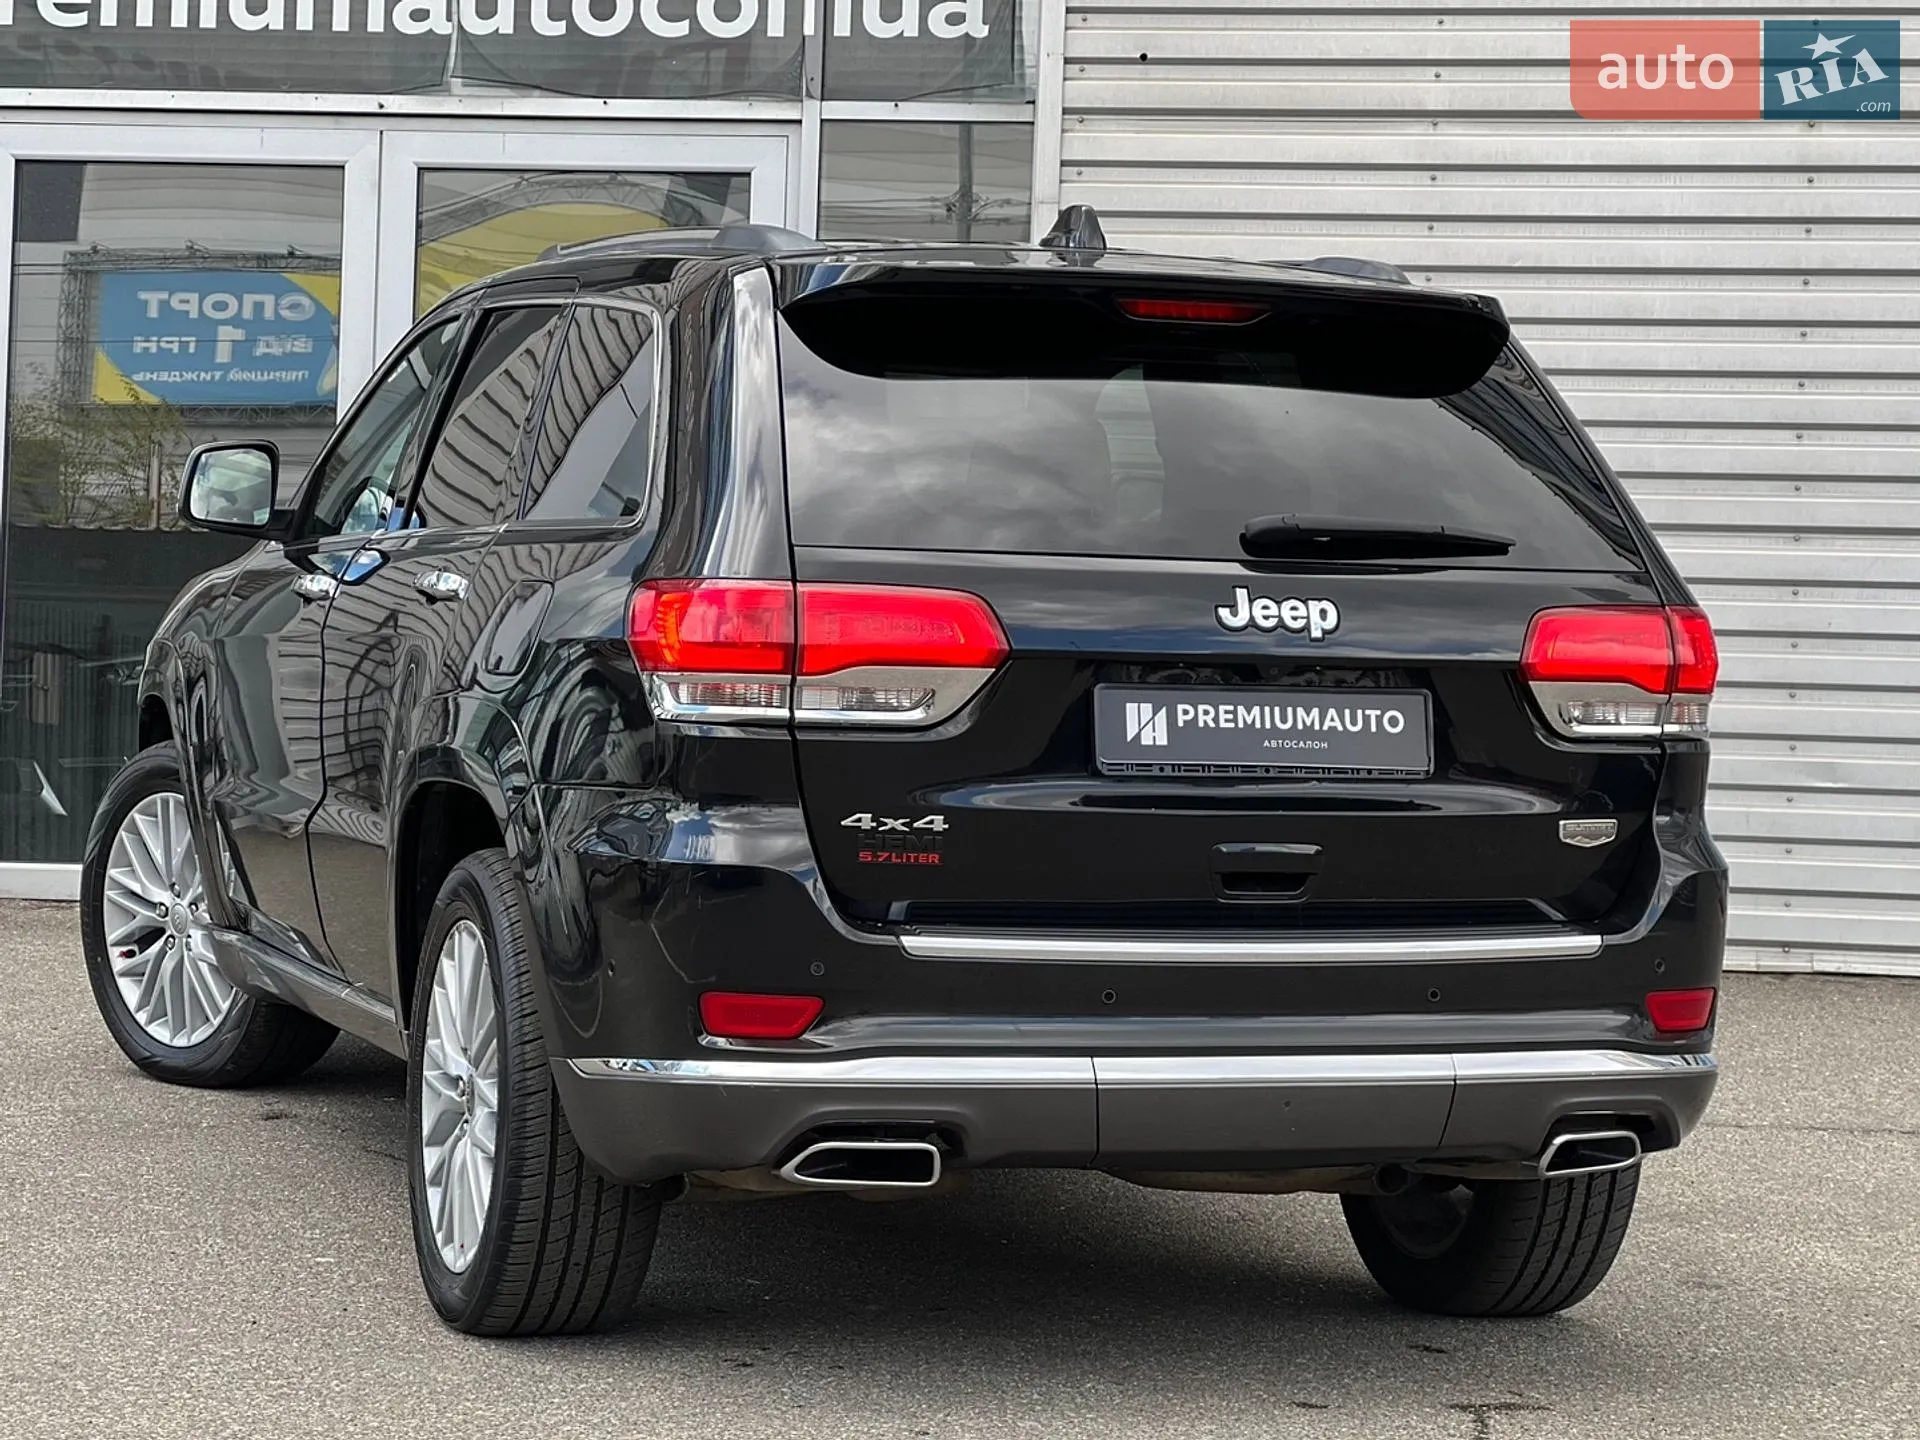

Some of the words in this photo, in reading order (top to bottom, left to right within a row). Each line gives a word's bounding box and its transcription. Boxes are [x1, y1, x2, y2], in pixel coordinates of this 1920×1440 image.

[1216, 586, 1339, 638] Jeep
[1177, 704, 1405, 733] PREMIUMAUTO
[1263, 739, 1328, 749] АВТОСАЛОН
[840, 813, 949, 831] 4x4
